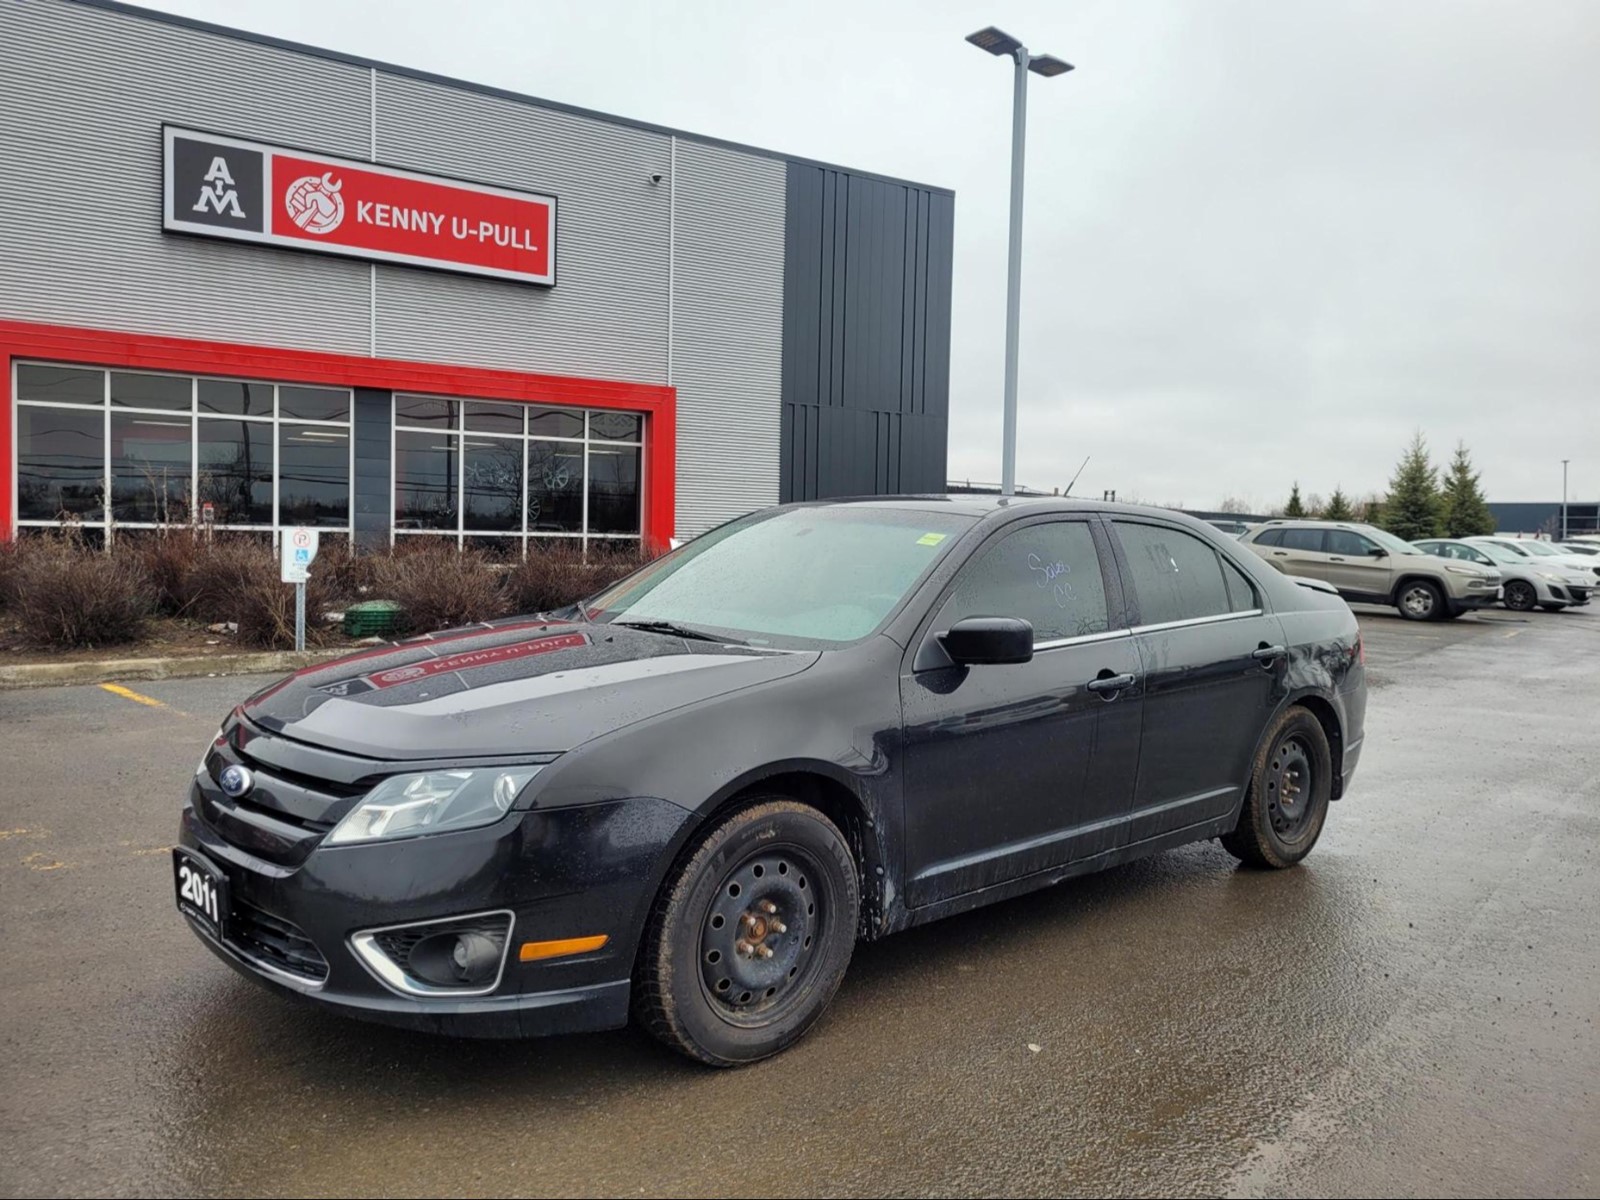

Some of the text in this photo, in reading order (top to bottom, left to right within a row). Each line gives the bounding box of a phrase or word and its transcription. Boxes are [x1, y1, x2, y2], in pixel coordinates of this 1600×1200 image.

[357, 200, 538, 251] KENNY U-PULL
[179, 866, 219, 923] 2011
